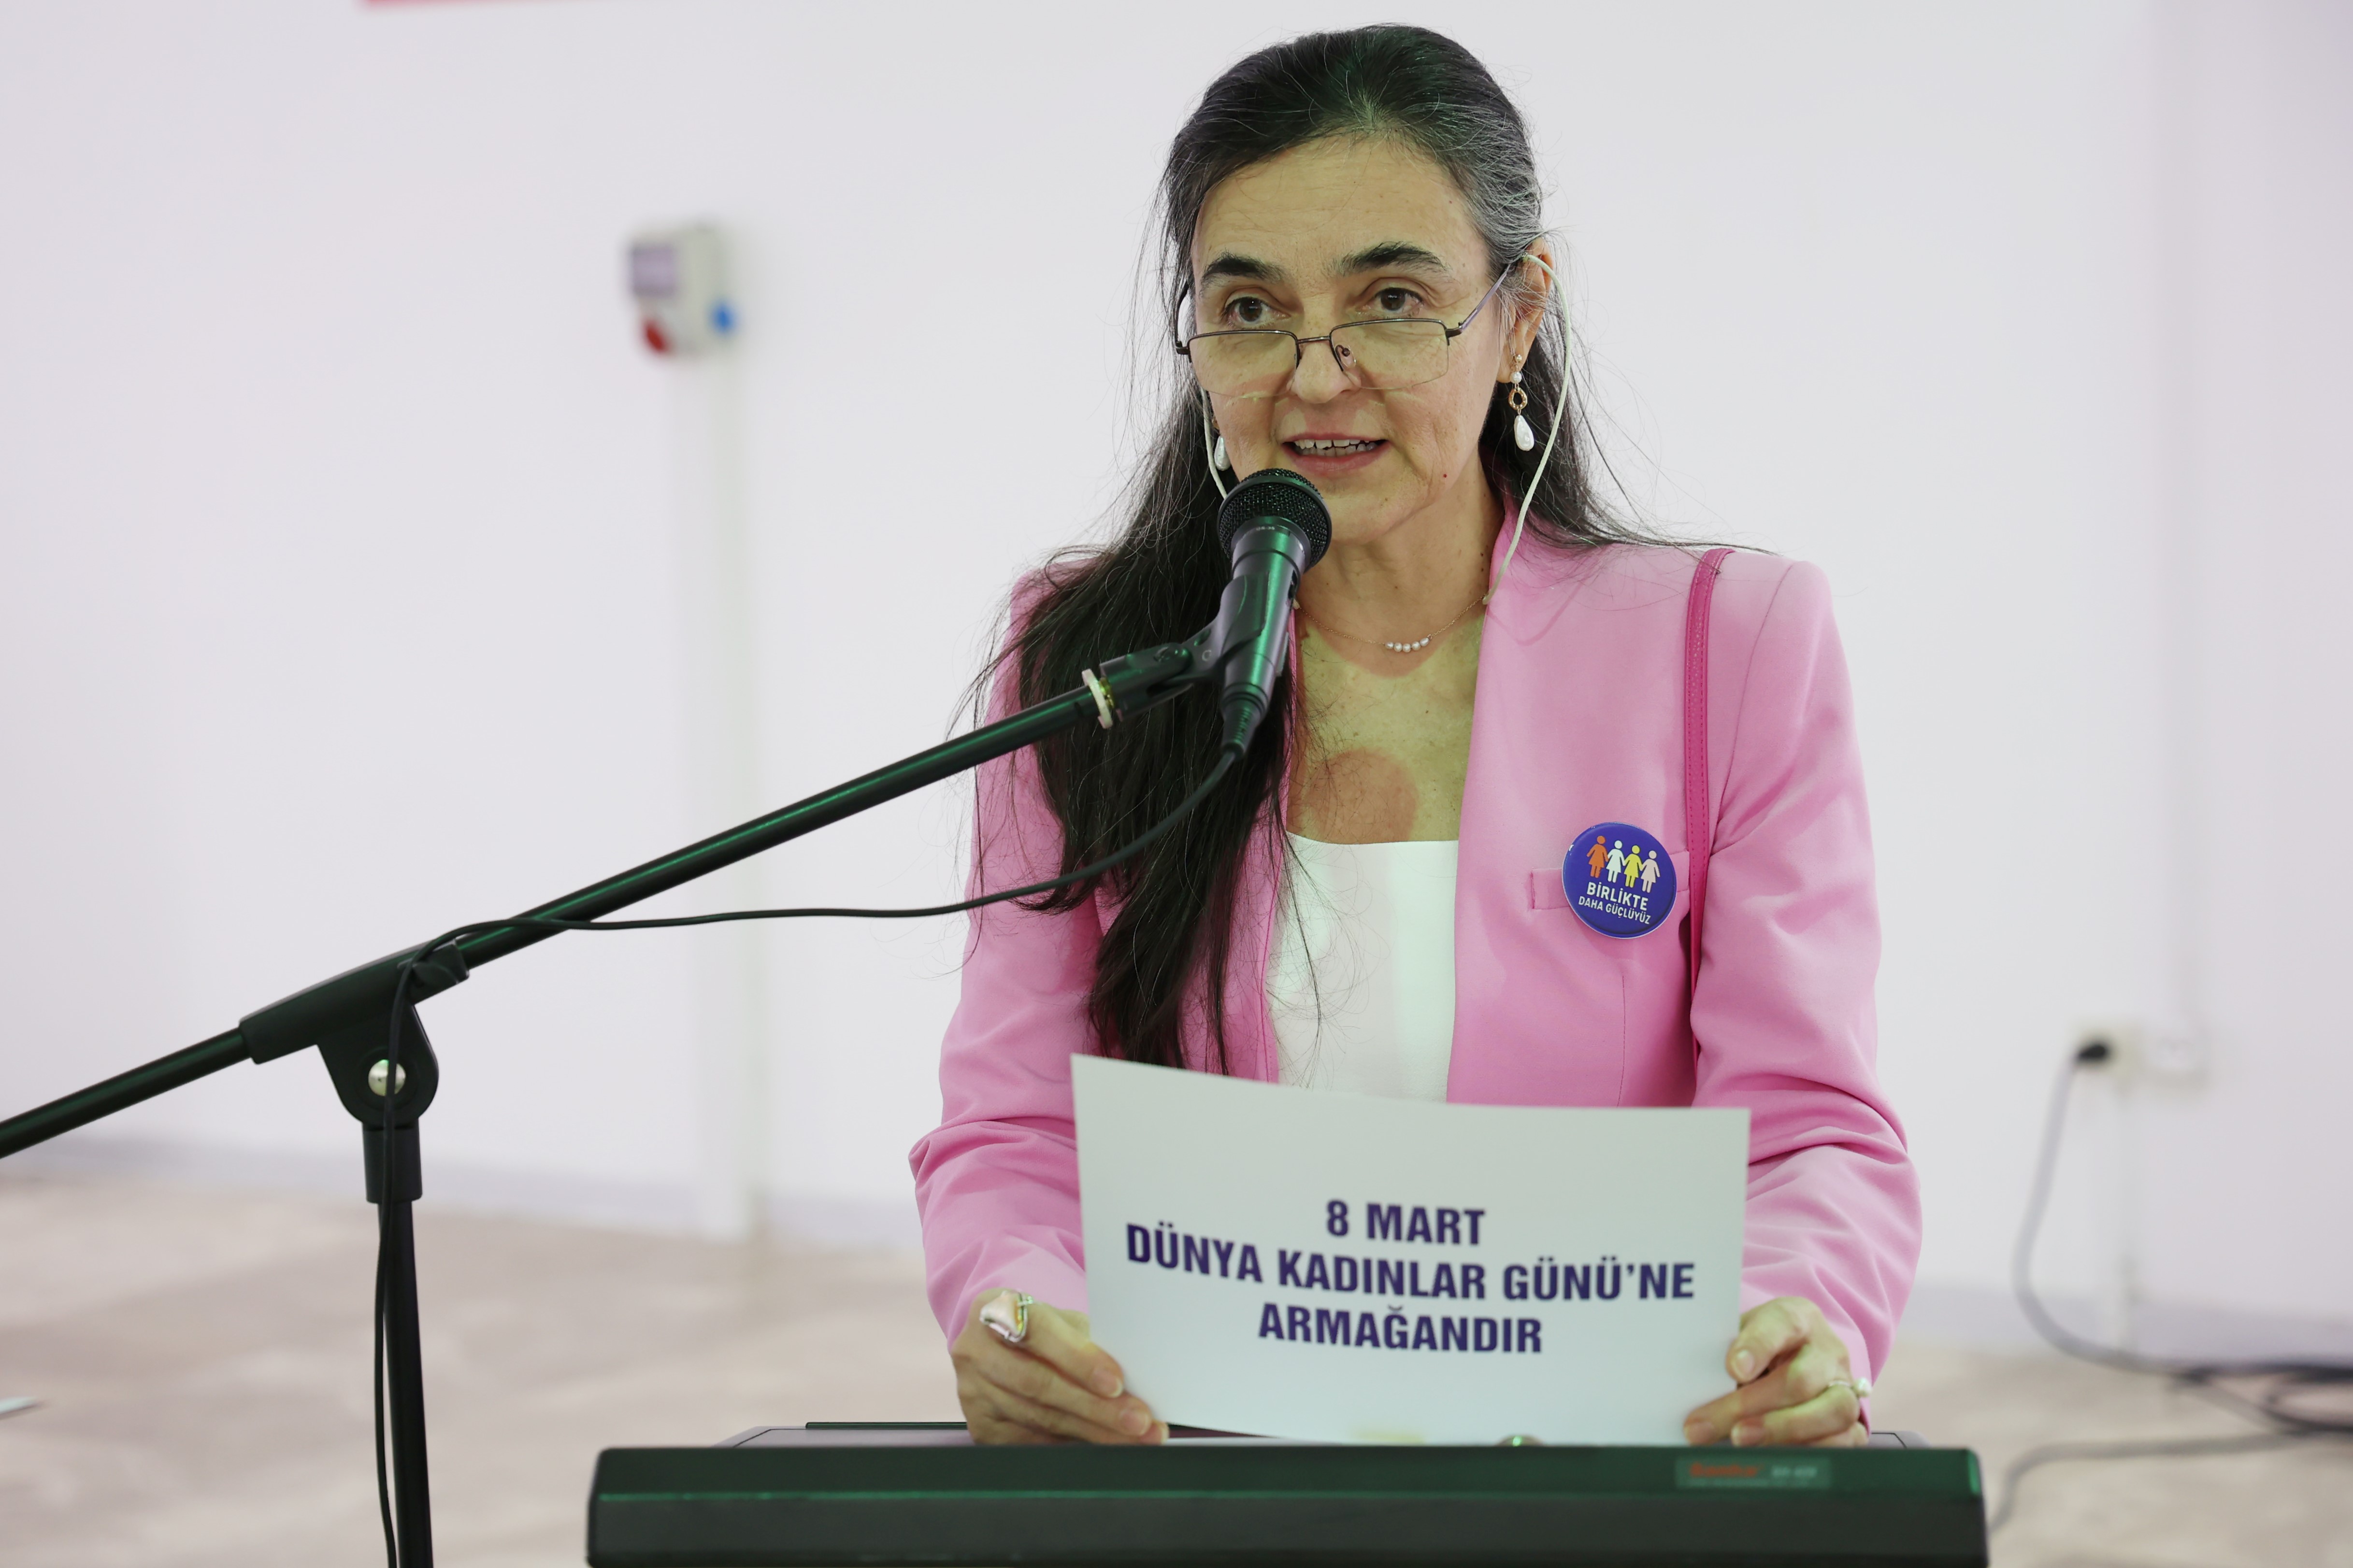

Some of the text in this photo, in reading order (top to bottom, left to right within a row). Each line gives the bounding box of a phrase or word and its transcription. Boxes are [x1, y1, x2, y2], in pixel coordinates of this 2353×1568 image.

[1578, 896, 1651, 925] DAHA GÜÇLÜYÜZ
[1586, 881, 1649, 911] BİRLİKTE
[1326, 1199, 1486, 1246] 8 MART
[1126, 1221, 1263, 1283] DÜNYA
[1277, 1249, 1486, 1300] KADINLAR
[1258, 1302, 1542, 1354] ARMAĞANDIR
